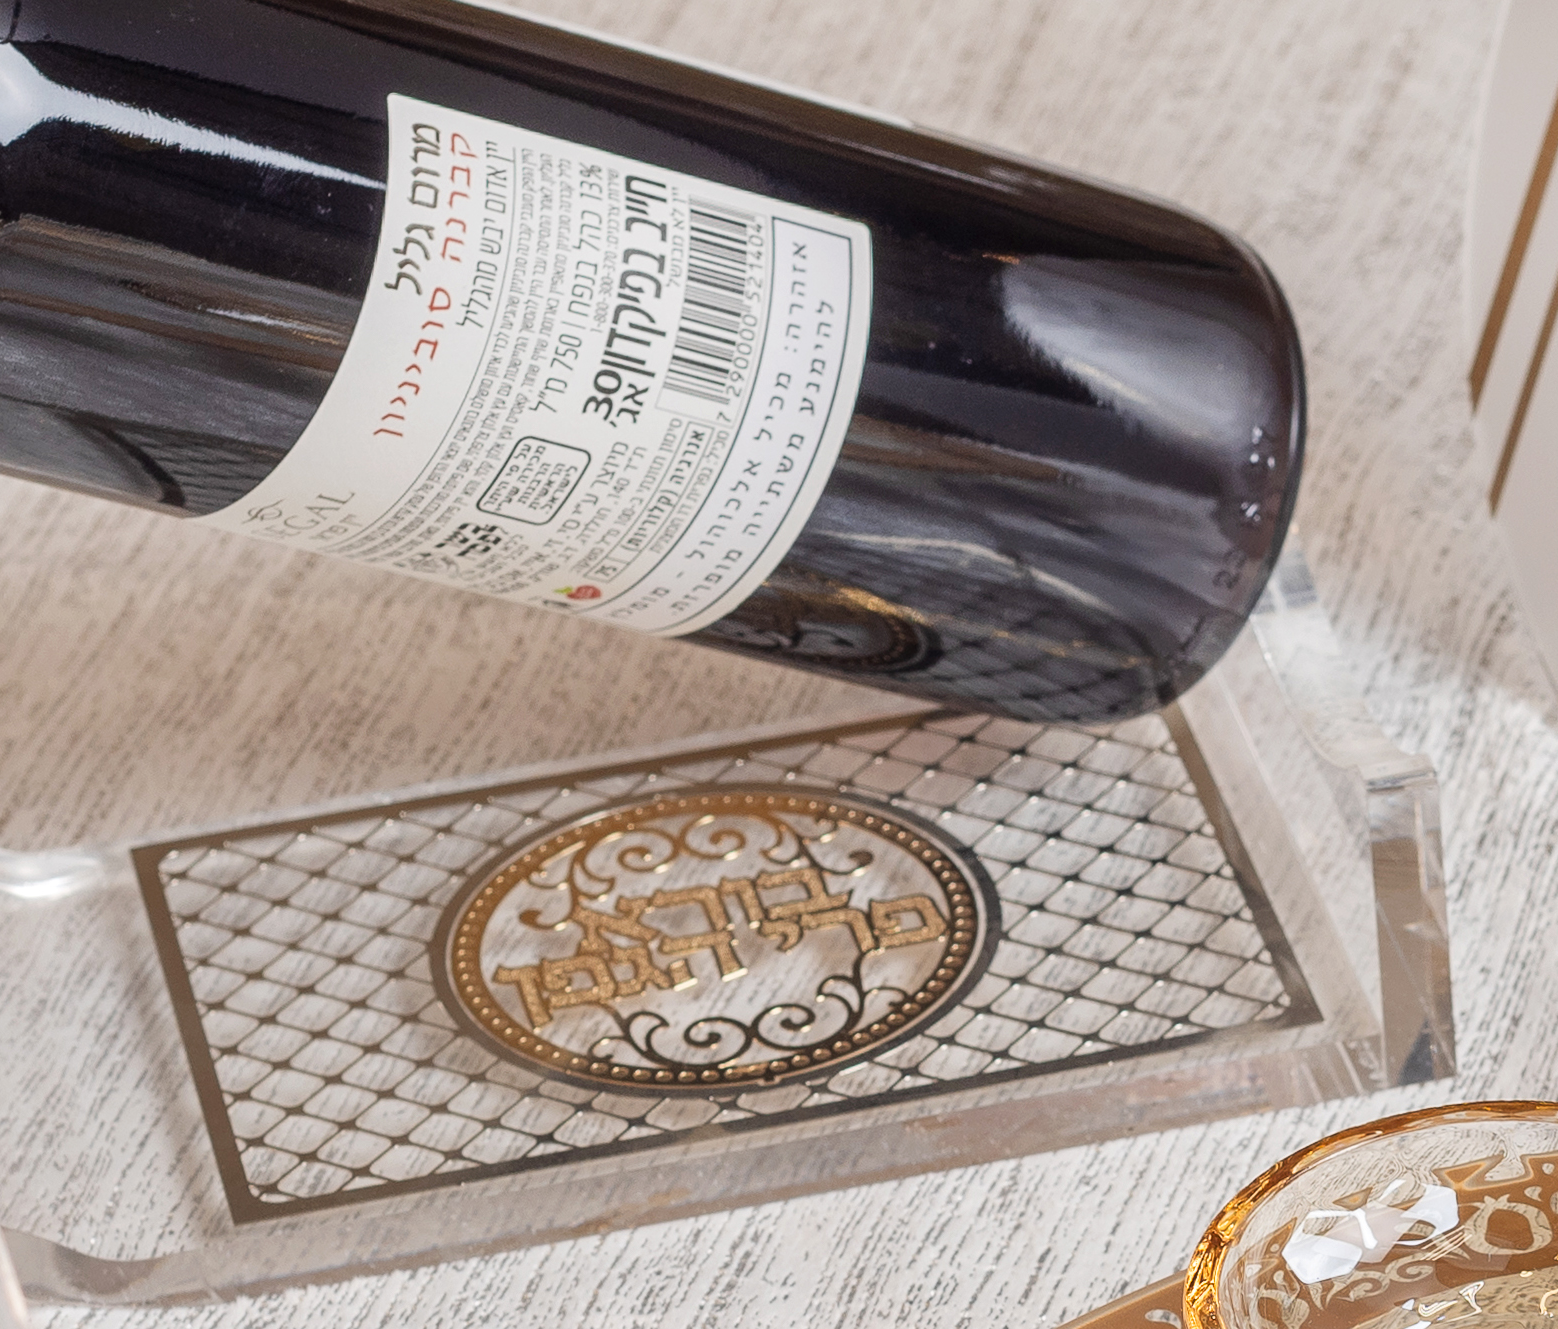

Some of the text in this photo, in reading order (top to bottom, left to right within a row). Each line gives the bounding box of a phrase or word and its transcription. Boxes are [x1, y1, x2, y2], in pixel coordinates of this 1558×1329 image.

[579, 162, 602, 200] 13%
[549, 333, 582, 370] 750
[725, 311, 759, 398] 290000
[573, 866, 852, 956] בורא
[493, 930, 748, 1031] הגפן
